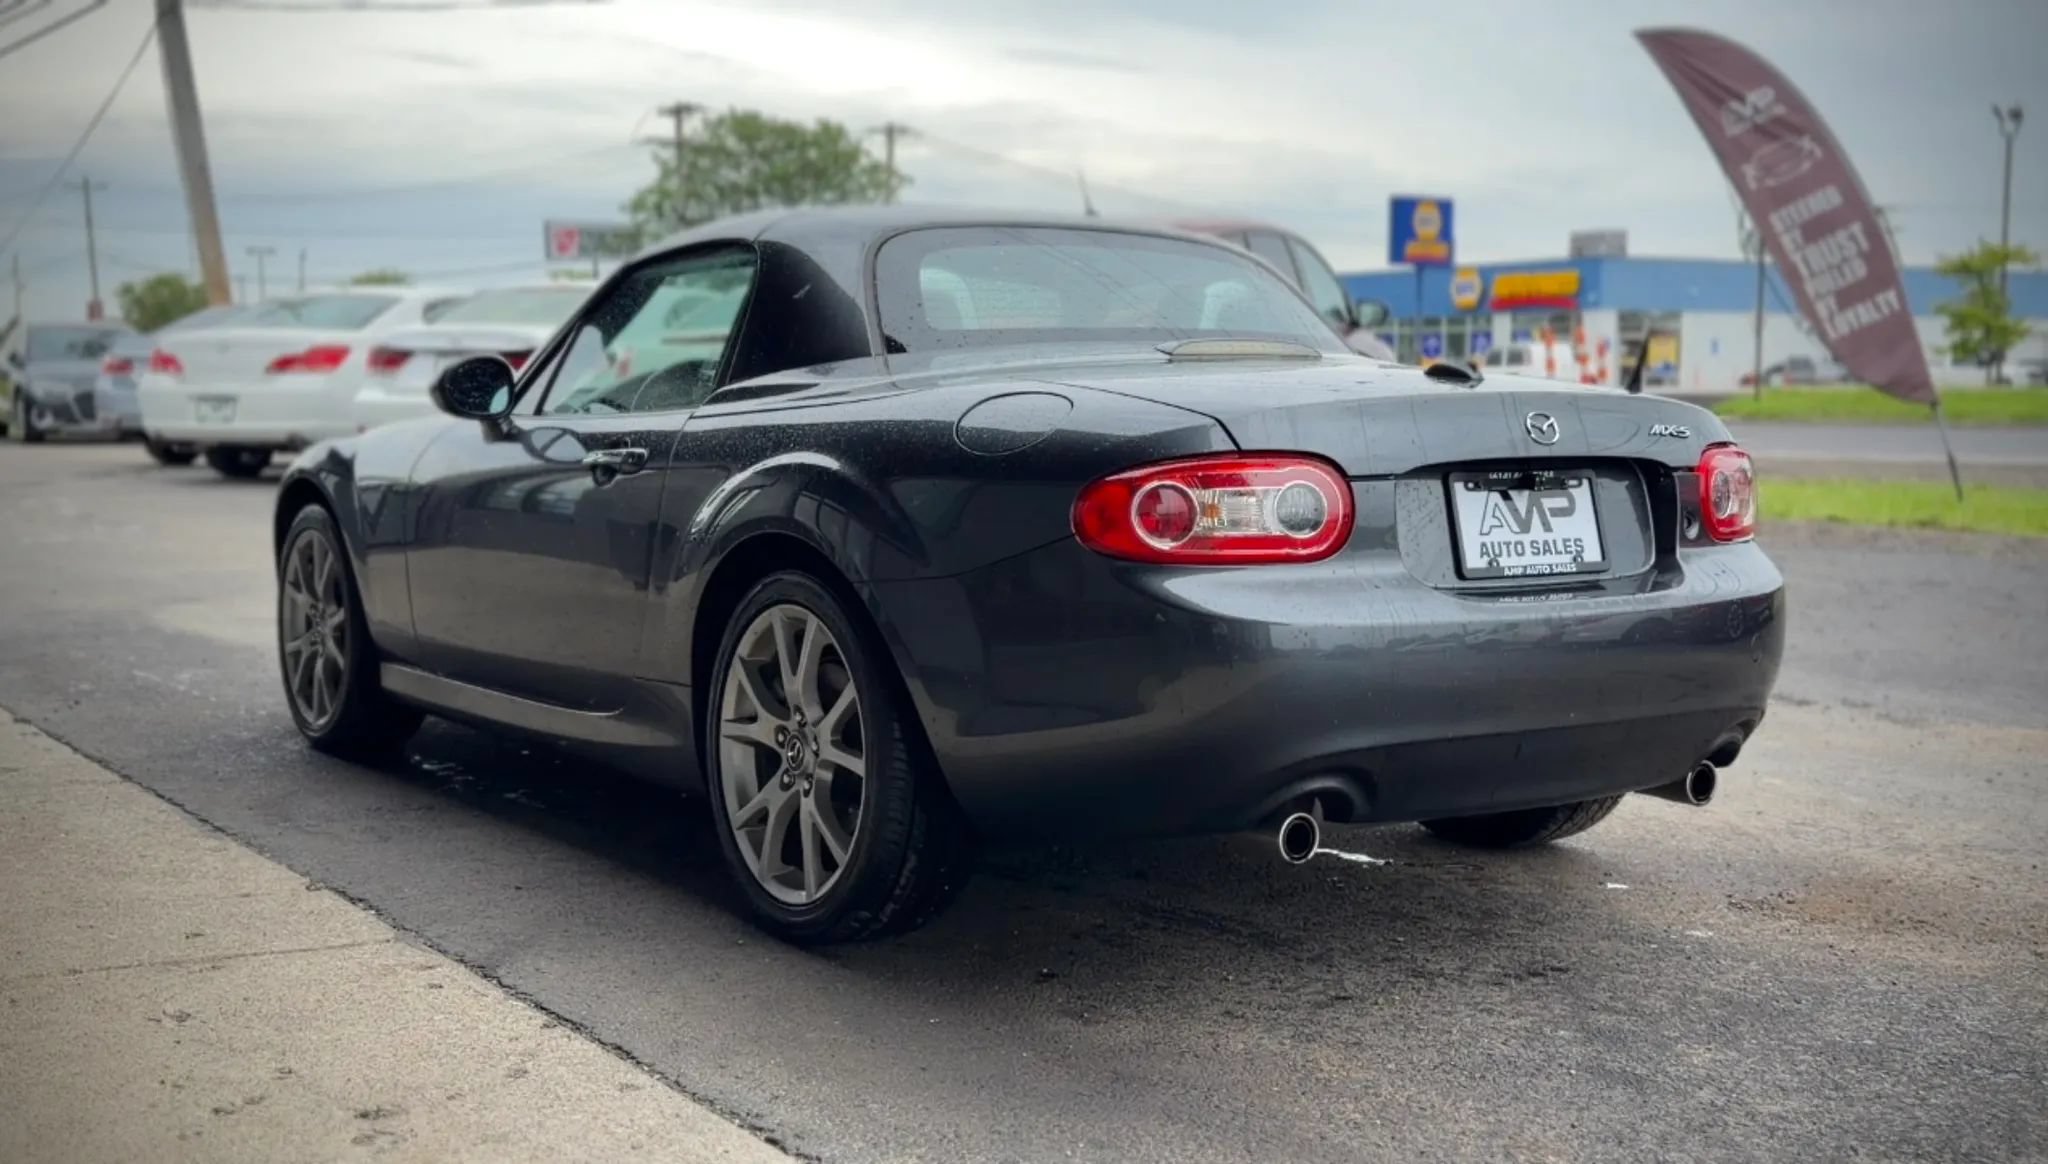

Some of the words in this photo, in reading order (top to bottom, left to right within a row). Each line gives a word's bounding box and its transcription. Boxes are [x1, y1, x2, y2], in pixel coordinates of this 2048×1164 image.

[1790, 220, 1871, 280] TRUST
[1822, 287, 1902, 340] LOYALTY
[1480, 540, 1526, 559] AUTO
[1530, 537, 1585, 557] SALES
[1504, 567, 1525, 576] AMP
[1526, 566, 1550, 575] AUTO
[1552, 563, 1577, 573] SALES
